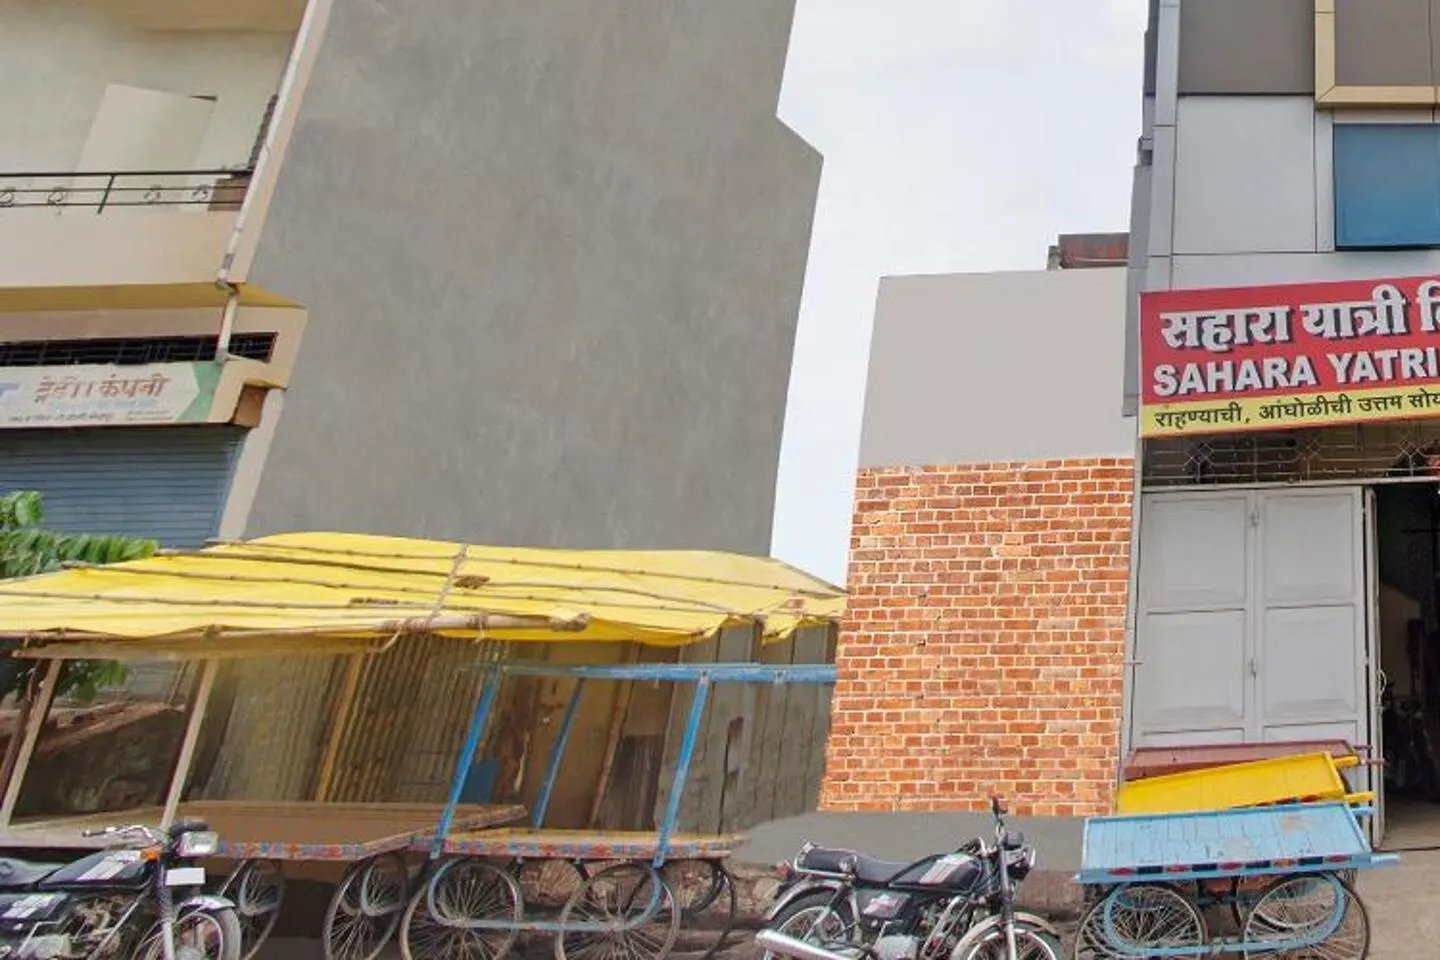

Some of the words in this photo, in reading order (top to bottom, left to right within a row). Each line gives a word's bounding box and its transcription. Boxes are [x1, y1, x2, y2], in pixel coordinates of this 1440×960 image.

[1160, 304, 1290, 350] सहारा
[1301, 283, 1408, 340] यात्री
[1152, 355, 1318, 396] SAHARA
[1326, 347, 1438, 384] YATRI
[1357, 393, 1403, 413] उत्तम
